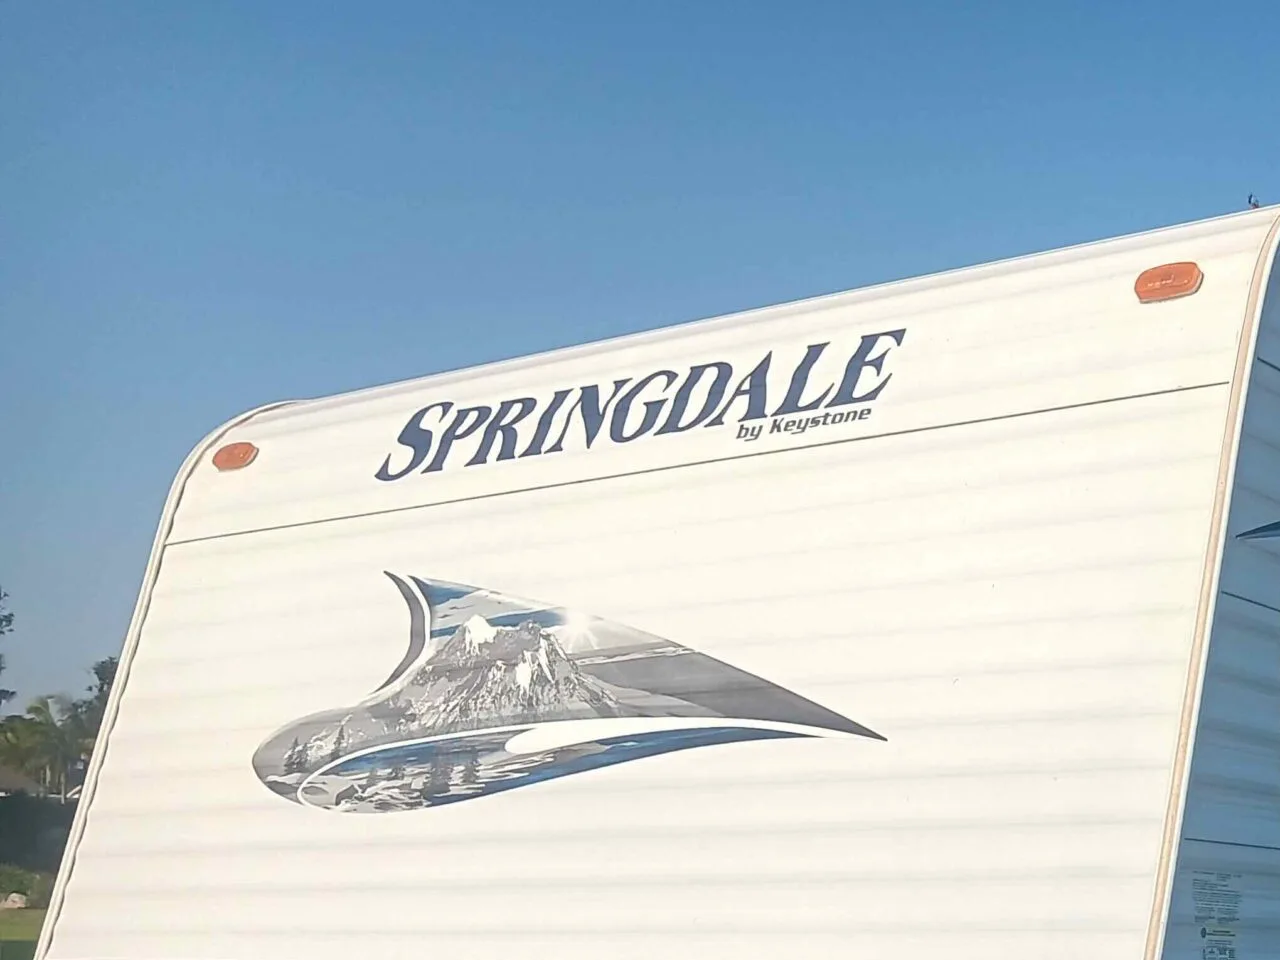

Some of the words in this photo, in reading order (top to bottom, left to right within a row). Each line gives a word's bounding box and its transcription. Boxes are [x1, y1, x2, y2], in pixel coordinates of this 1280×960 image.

[374, 328, 907, 482] SPRINGDALE
[736, 424, 763, 442] by
[769, 408, 872, 435] Keystone
